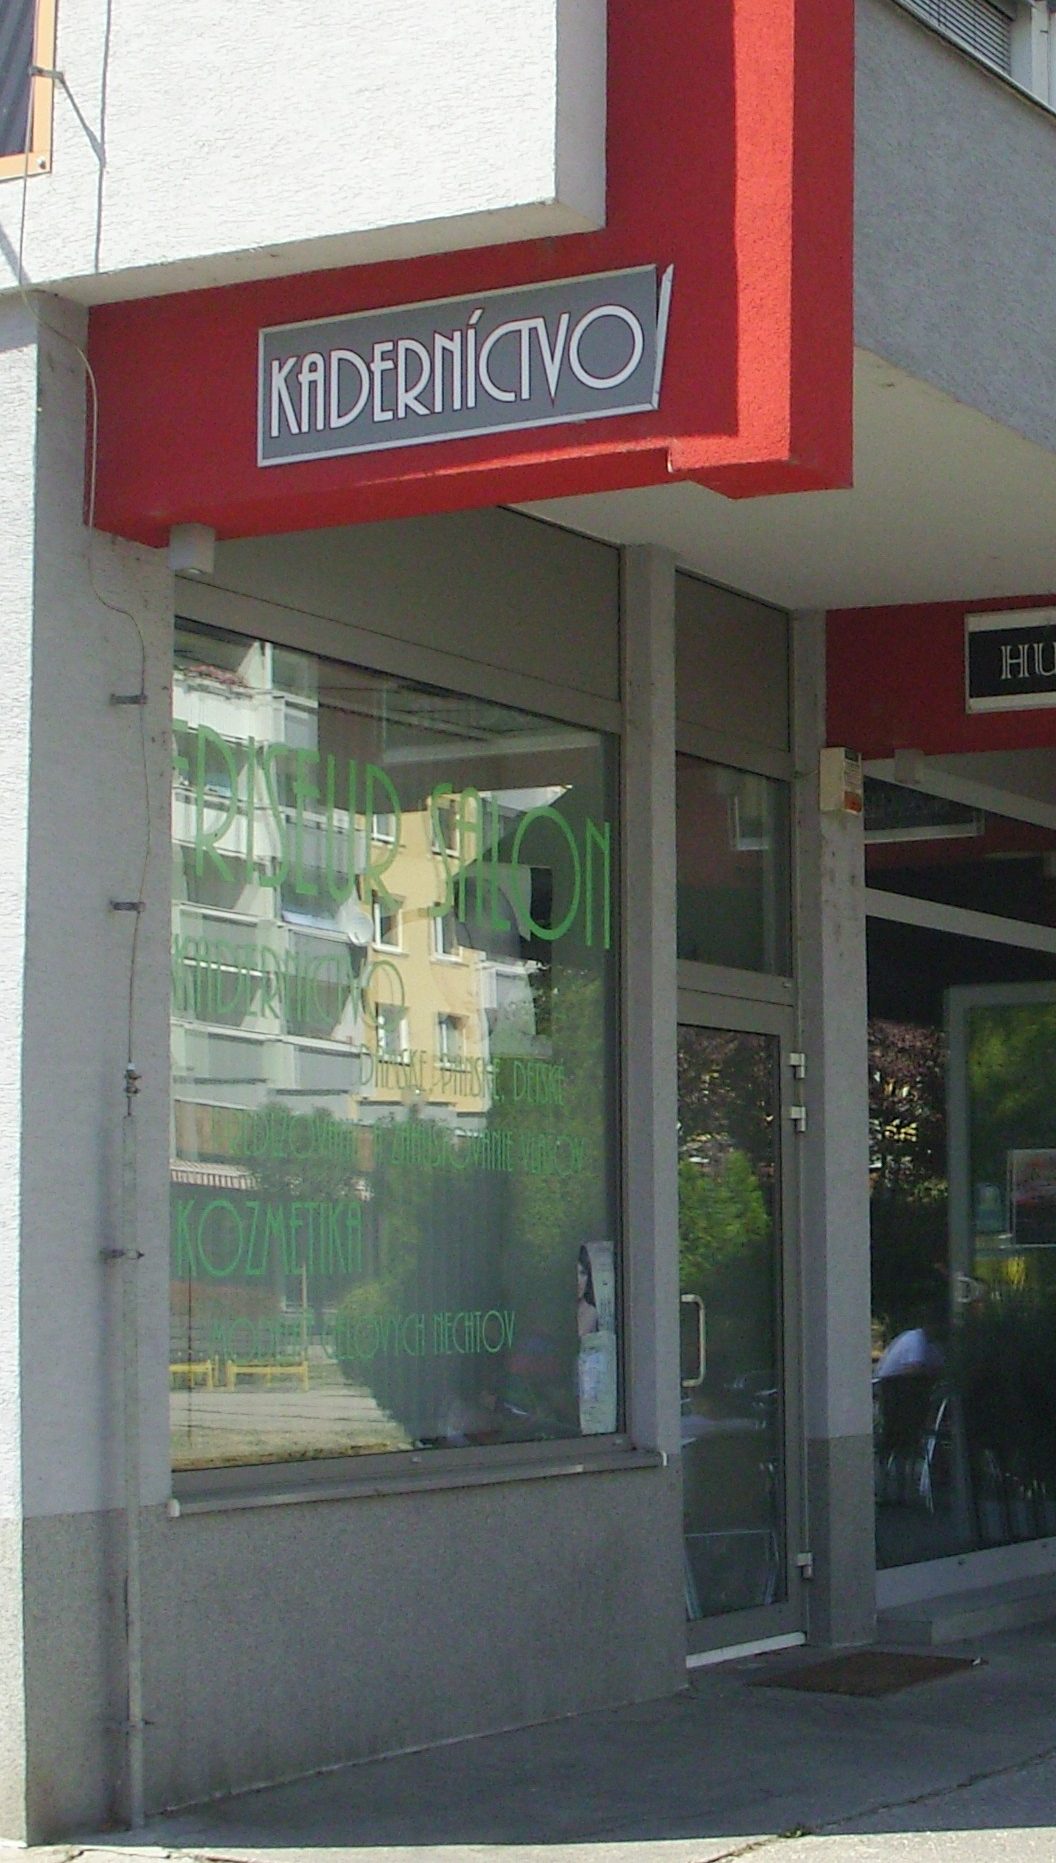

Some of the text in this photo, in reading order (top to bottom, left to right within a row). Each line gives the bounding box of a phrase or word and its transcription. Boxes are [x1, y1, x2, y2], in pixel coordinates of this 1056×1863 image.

[270, 304, 645, 438] KADERNÍCTVO
[430, 782, 611, 949] SALON
[174, 1198, 363, 1277] KOZMETIKA
[433, 1310, 516, 1355] NECHTOV
